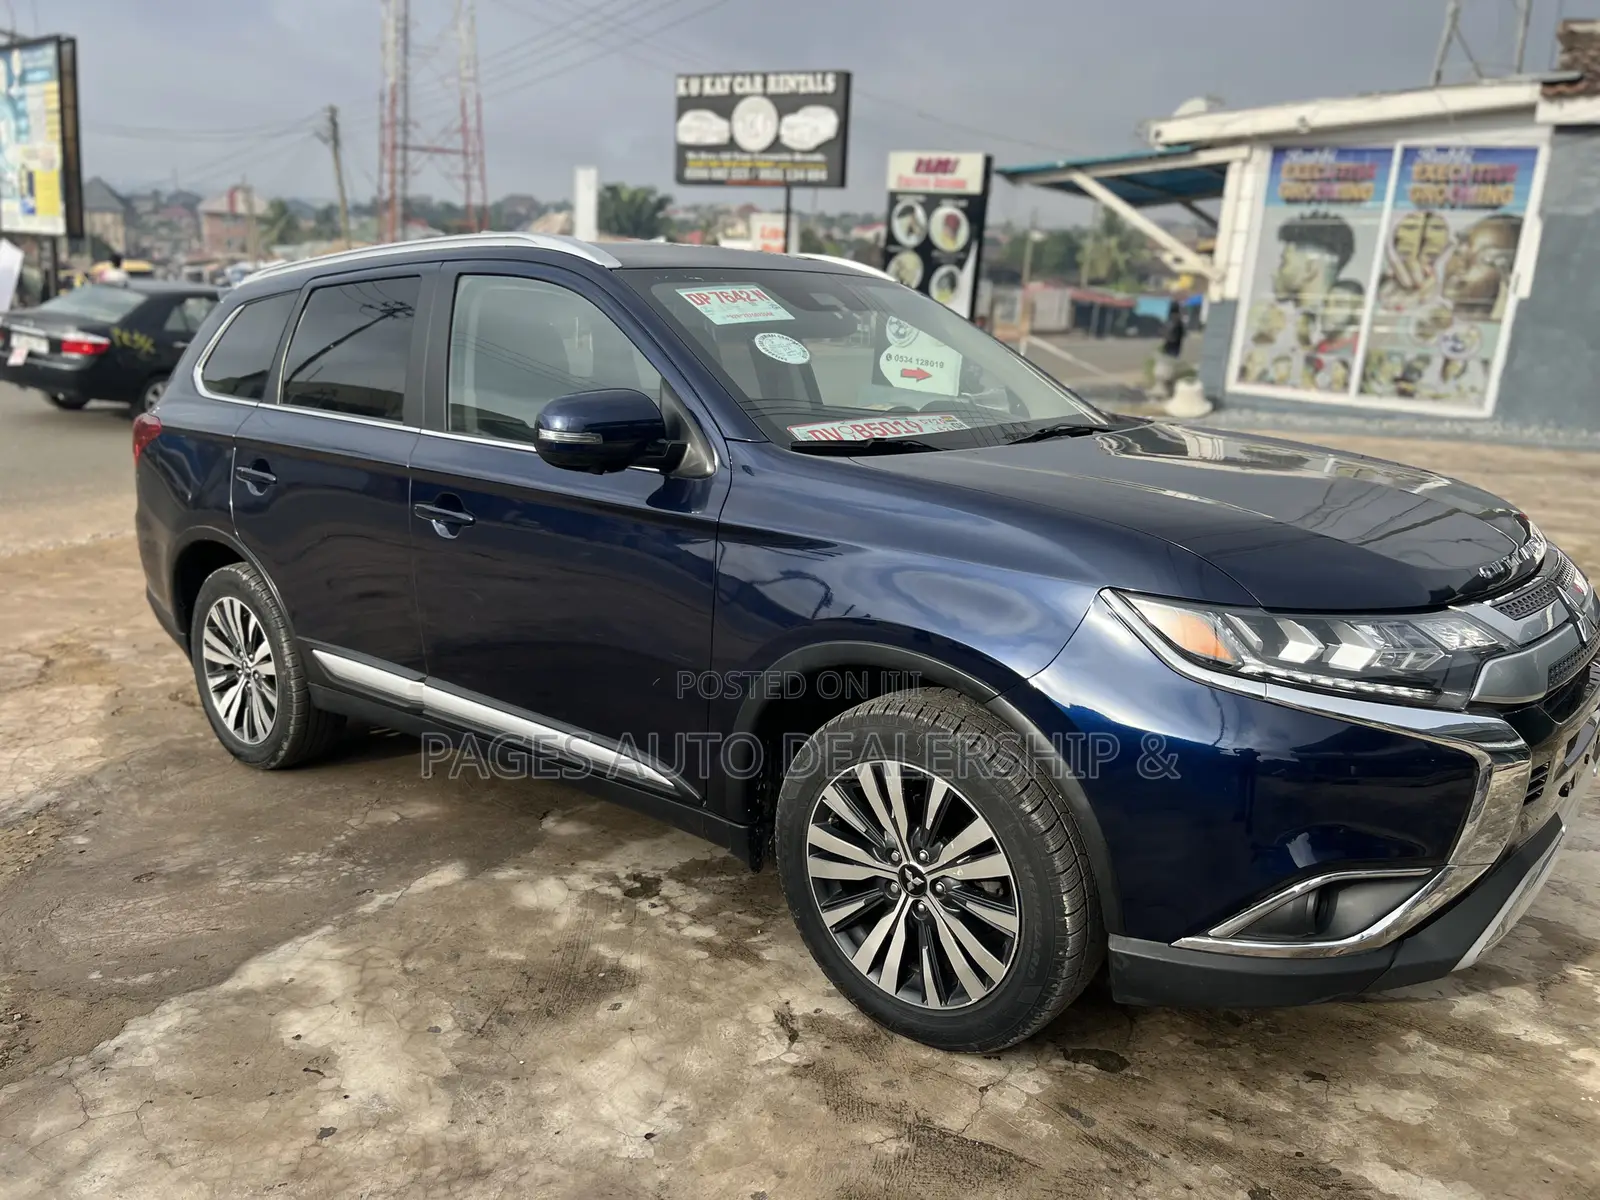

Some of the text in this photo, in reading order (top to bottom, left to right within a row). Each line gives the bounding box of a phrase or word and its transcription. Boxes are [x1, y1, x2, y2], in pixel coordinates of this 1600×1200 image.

[732, 74, 764, 95] CAR
[766, 72, 837, 94] RENTALS
[708, 289, 757, 304] 7642
[894, 354, 945, 369] 0534 128019
